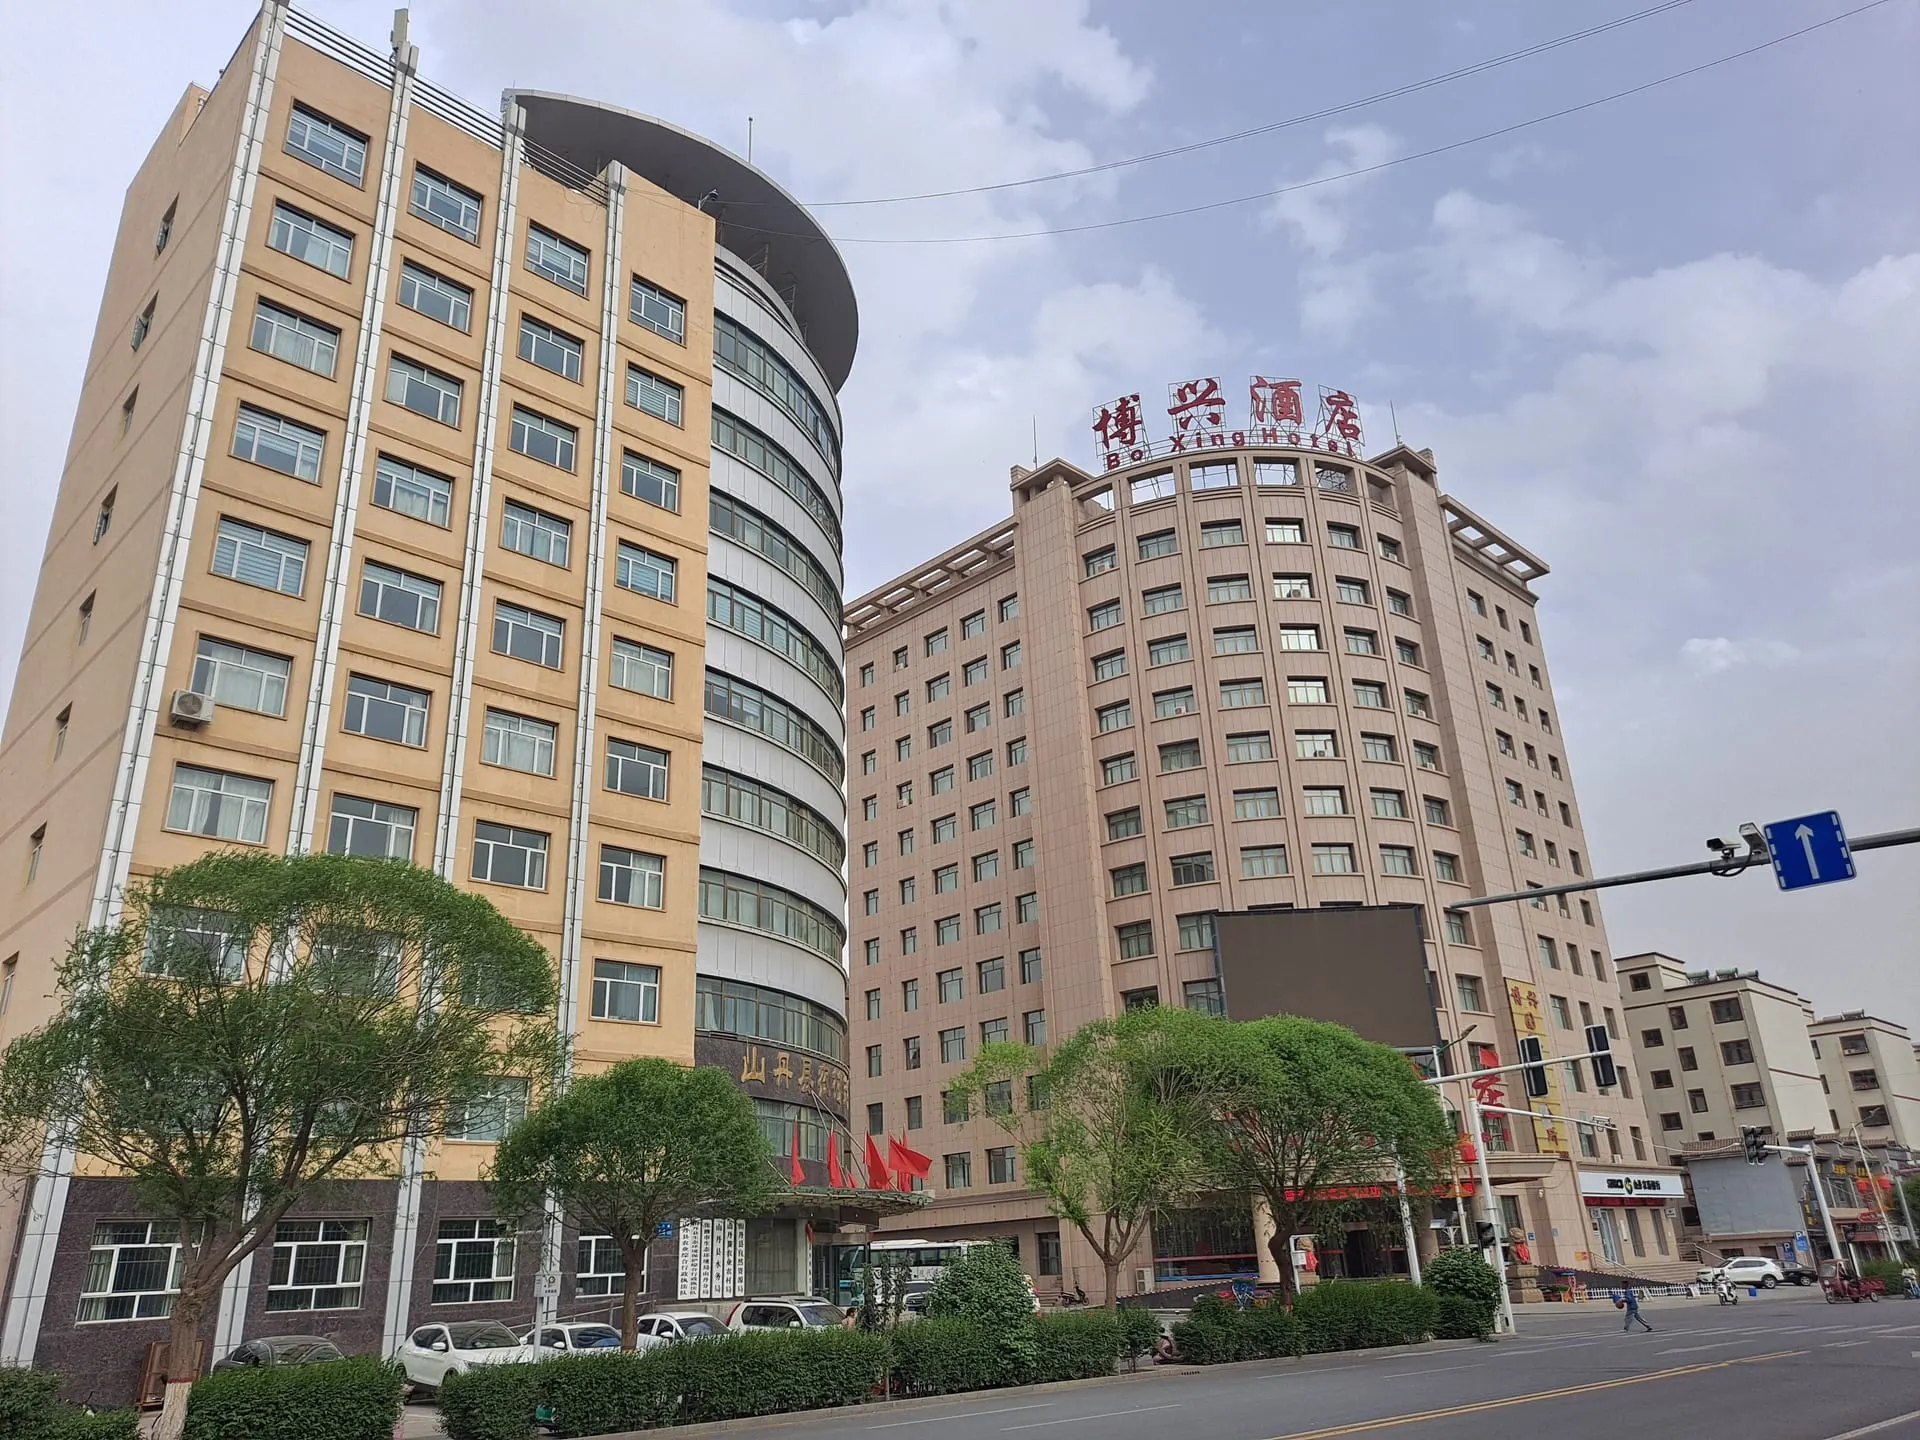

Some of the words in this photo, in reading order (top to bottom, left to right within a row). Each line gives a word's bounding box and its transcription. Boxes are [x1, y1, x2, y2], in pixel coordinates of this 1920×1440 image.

[1092, 375, 1361, 449] 博兴酒店
[1106, 449, 1144, 471] Bo
[1169, 431, 1245, 453] Xing
